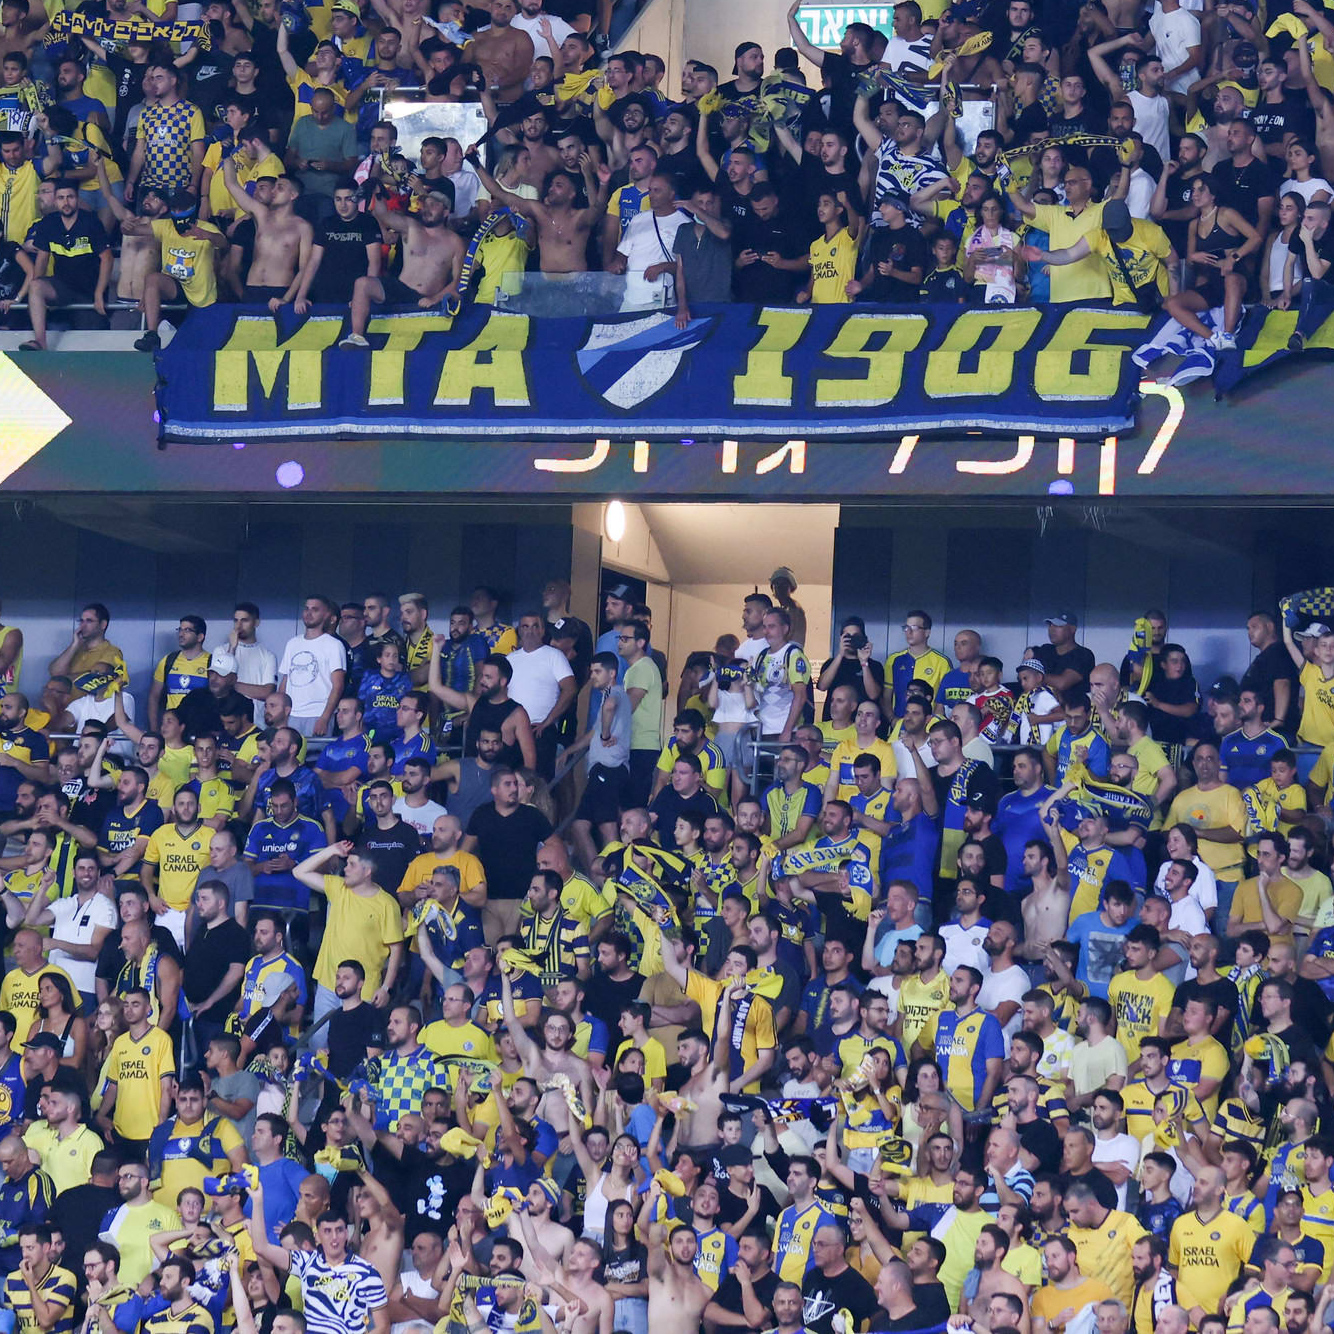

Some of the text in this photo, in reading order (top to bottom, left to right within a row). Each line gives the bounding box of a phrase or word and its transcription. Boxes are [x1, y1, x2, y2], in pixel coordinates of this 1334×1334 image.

[200, 66, 218, 74] NIKE
[214, 307, 1151, 411] MTA 1906
[262, 845, 287, 853] unicef
[368, 842, 405, 850] Champion
[166, 855, 197, 863] ISRAEL
[163, 864, 201, 873] CANADA
[936, 1046, 968, 1055] CANADA
[121, 1061, 145, 1070] ISRAEL
[119, 1070, 149, 1080] CANADA
[1183, 1247, 1215, 1256] ISRAEL
